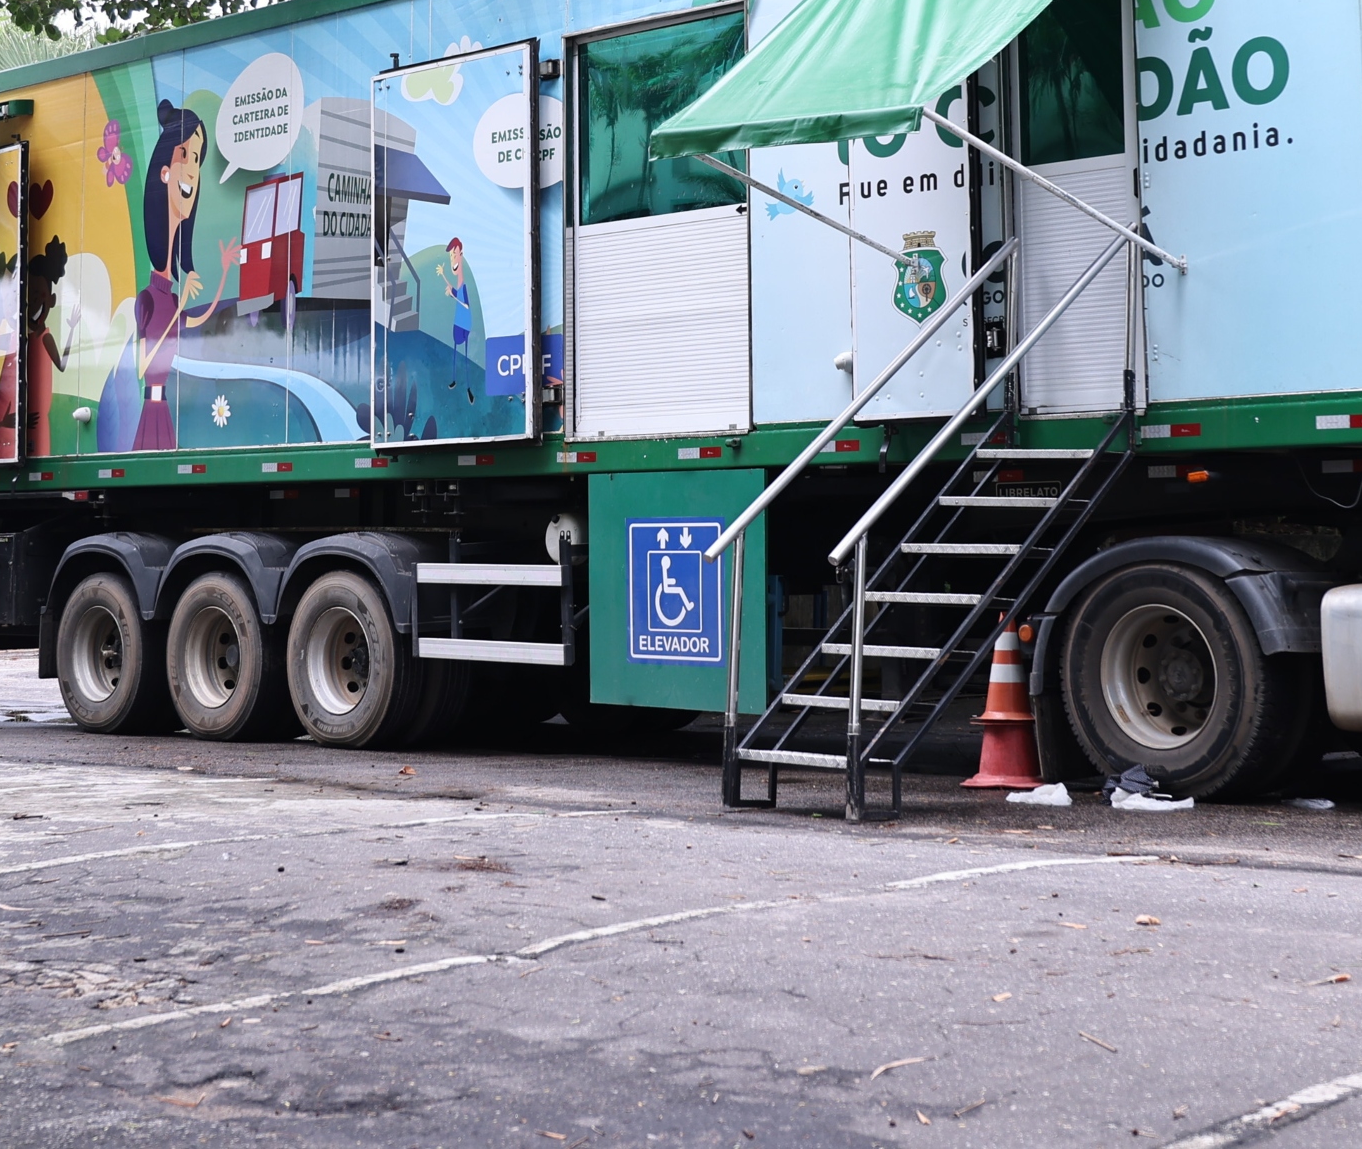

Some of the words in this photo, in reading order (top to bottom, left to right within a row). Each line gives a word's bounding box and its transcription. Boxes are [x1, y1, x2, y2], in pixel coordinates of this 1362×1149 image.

[234, 87, 274, 108] EMISSÃO
[275, 87, 288, 100] DA
[232, 107, 276, 126] CARTEIRA
[277, 104, 289, 117] DE
[233, 123, 289, 143] IDENTIDADE
[498, 150, 513, 163] DE
[327, 172, 372, 206] CAMINHA
[902, 172, 938, 194] em
[322, 211, 338, 237] DO
[339, 211, 372, 237] CIDADA
[999, 486, 1058, 498] LIBRELATO
[639, 635, 710, 653] ELEVADOR
